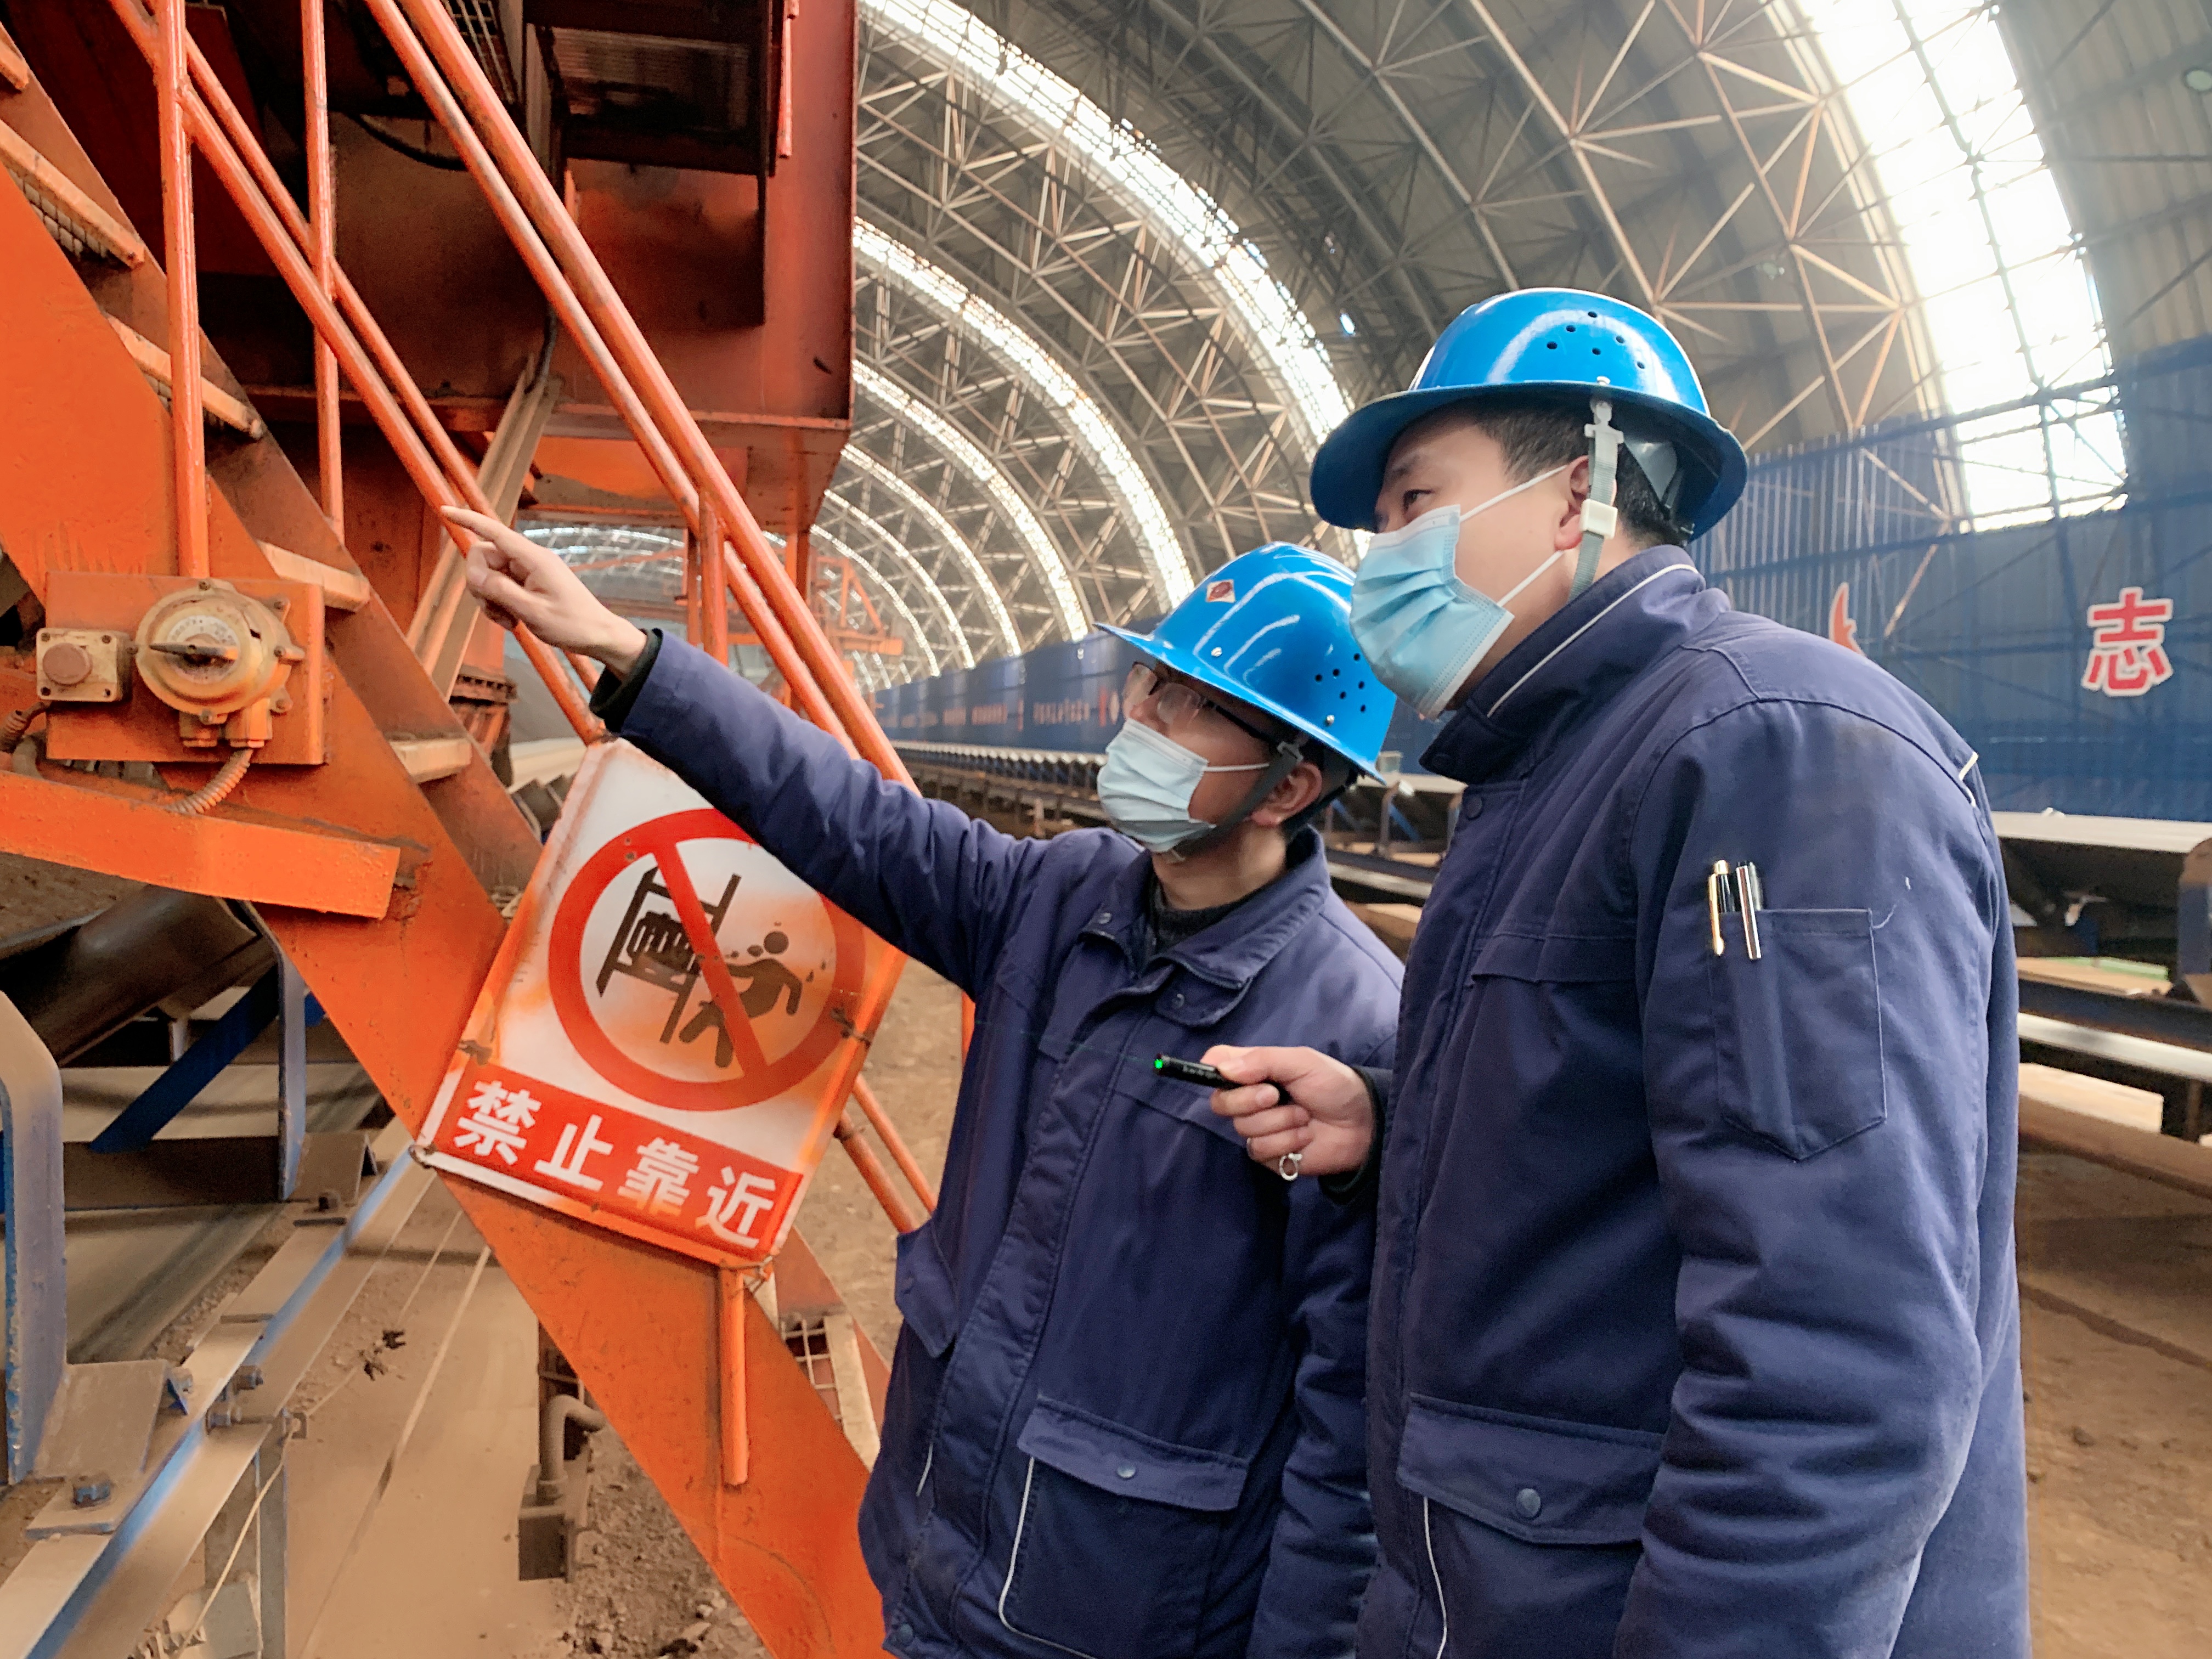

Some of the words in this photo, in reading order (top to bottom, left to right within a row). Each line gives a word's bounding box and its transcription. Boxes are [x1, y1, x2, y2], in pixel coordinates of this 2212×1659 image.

[2083, 588, 2173, 697] 志
[454, 1079, 777, 1247] 禁止靠近
